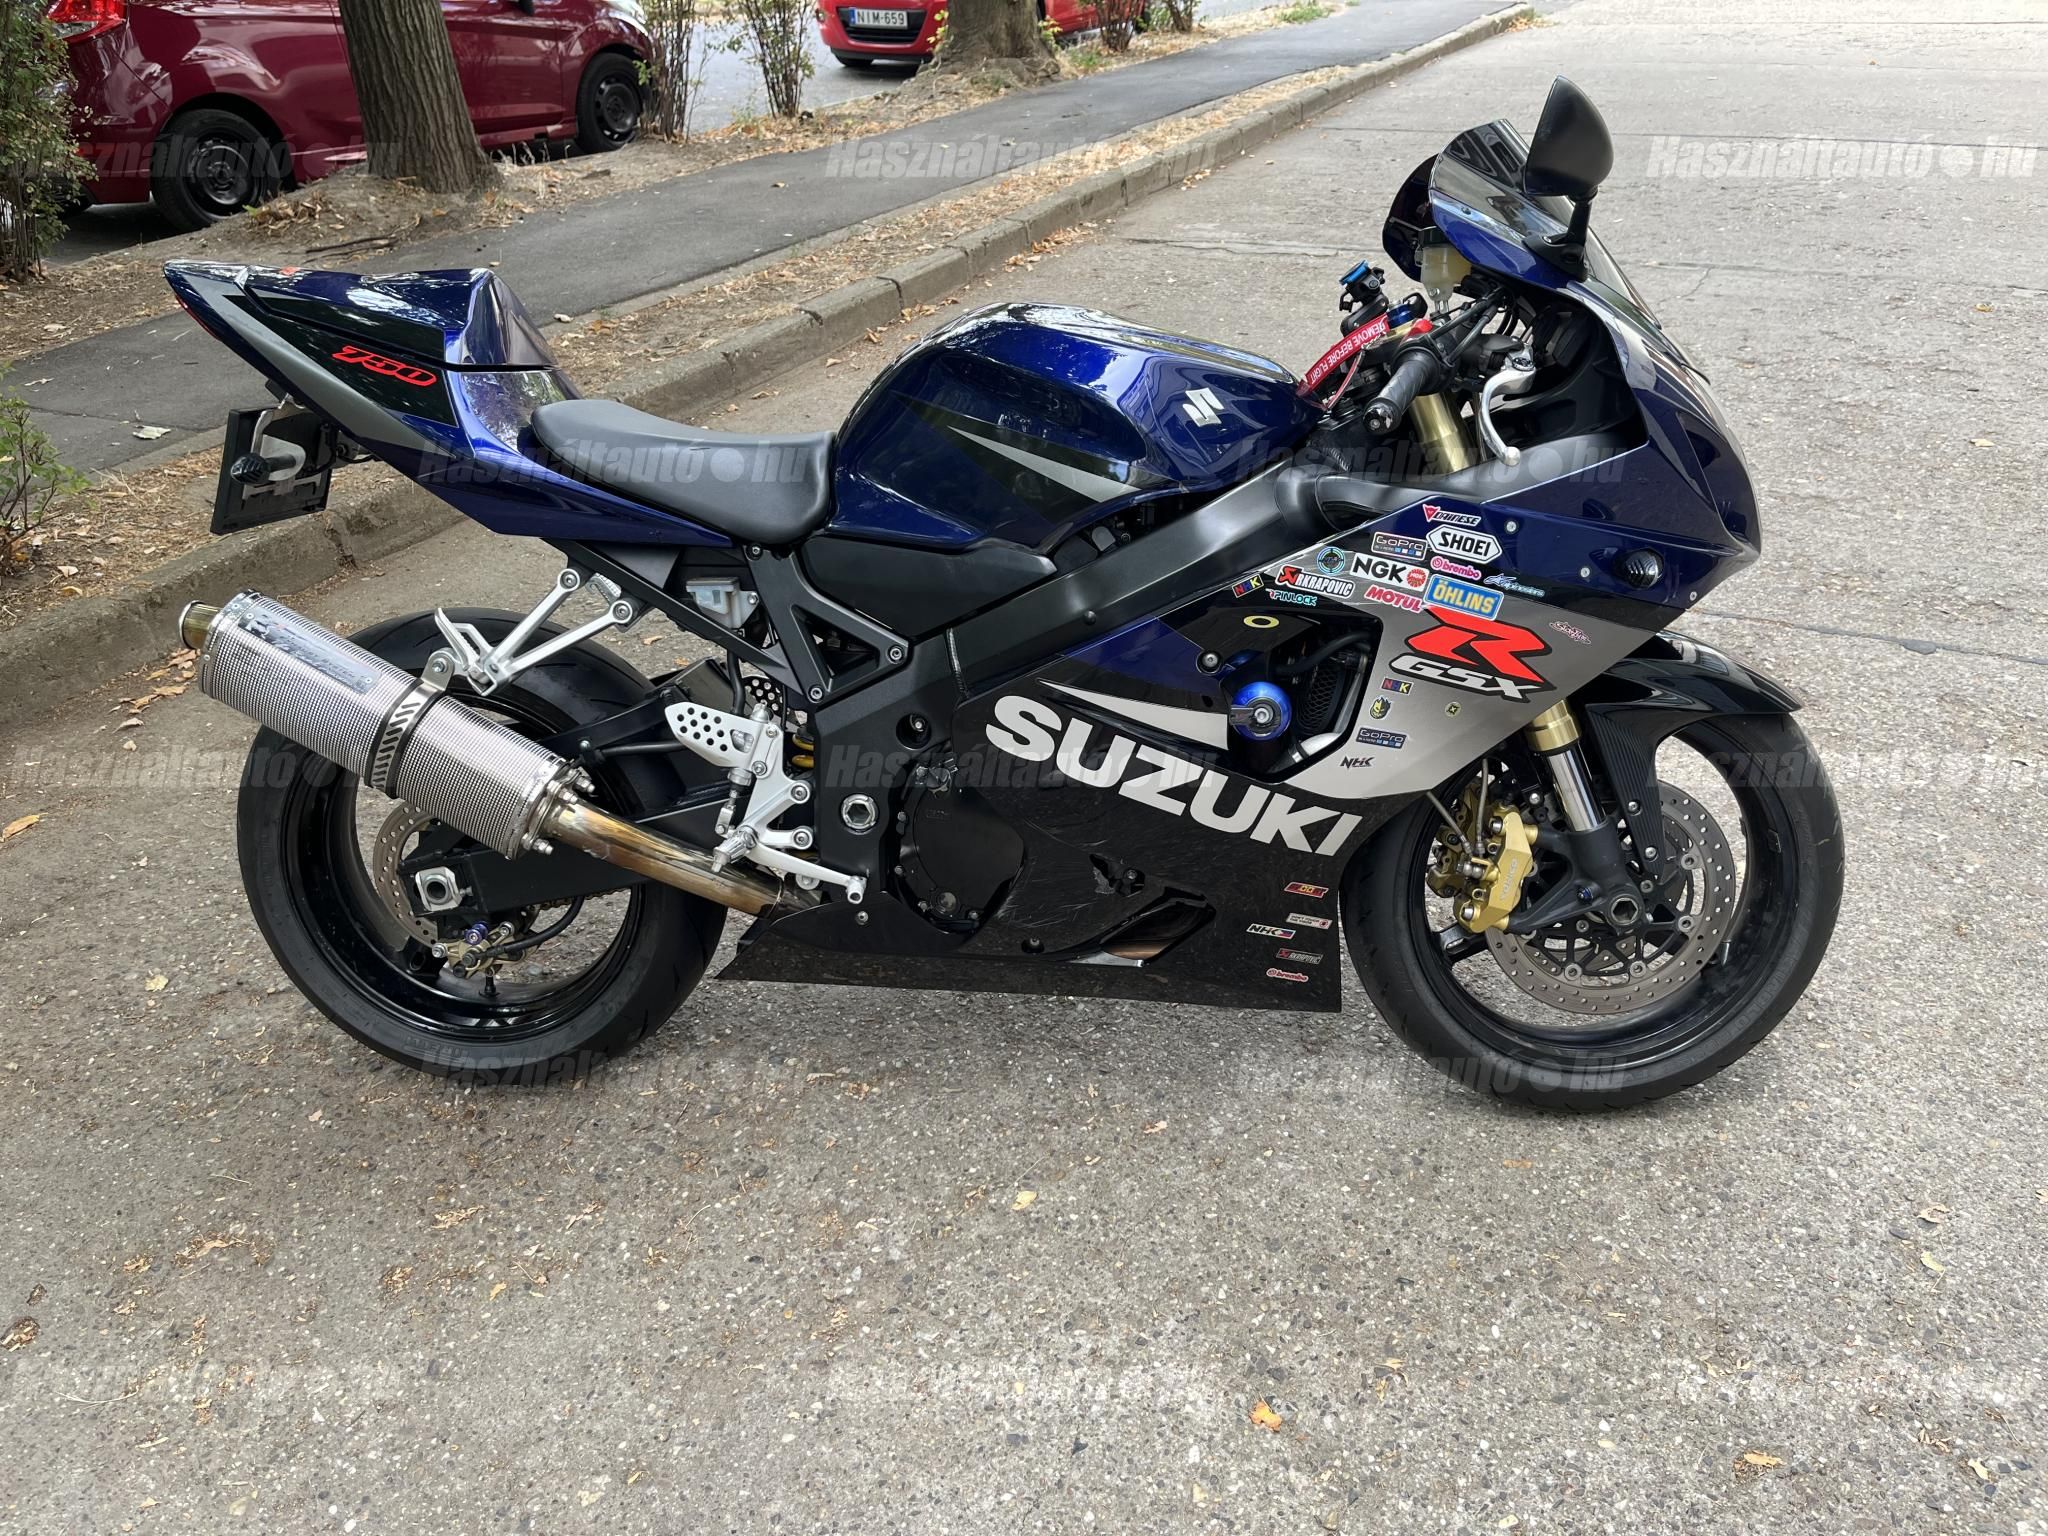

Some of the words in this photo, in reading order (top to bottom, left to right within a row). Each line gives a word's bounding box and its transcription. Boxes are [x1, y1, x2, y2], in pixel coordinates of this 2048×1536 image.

[857, 10, 905, 25] NIM-659
[1353, 322, 1386, 346] REMOVE
[1327, 340, 1354, 365] BEFORE
[332, 345, 436, 386] 750
[1310, 361, 1329, 384] FLIGHT
[1435, 511, 1480, 526] DAINESE
[1375, 535, 1424, 551] GoPro
[1438, 531, 1492, 557] SHOEI
[1352, 556, 1407, 584] NGK
[1442, 560, 1481, 579] brembo
[1274, 590, 1318, 606] PINLOCK
[1366, 585, 1422, 612] MOTUL
[1432, 582, 1495, 614] ÖHLINS
[1391, 655, 1542, 699] GSX
[1360, 729, 1404, 743] GoPro
[985, 695, 1363, 856] SUZUKI
[1276, 970, 1308, 982] brembo
